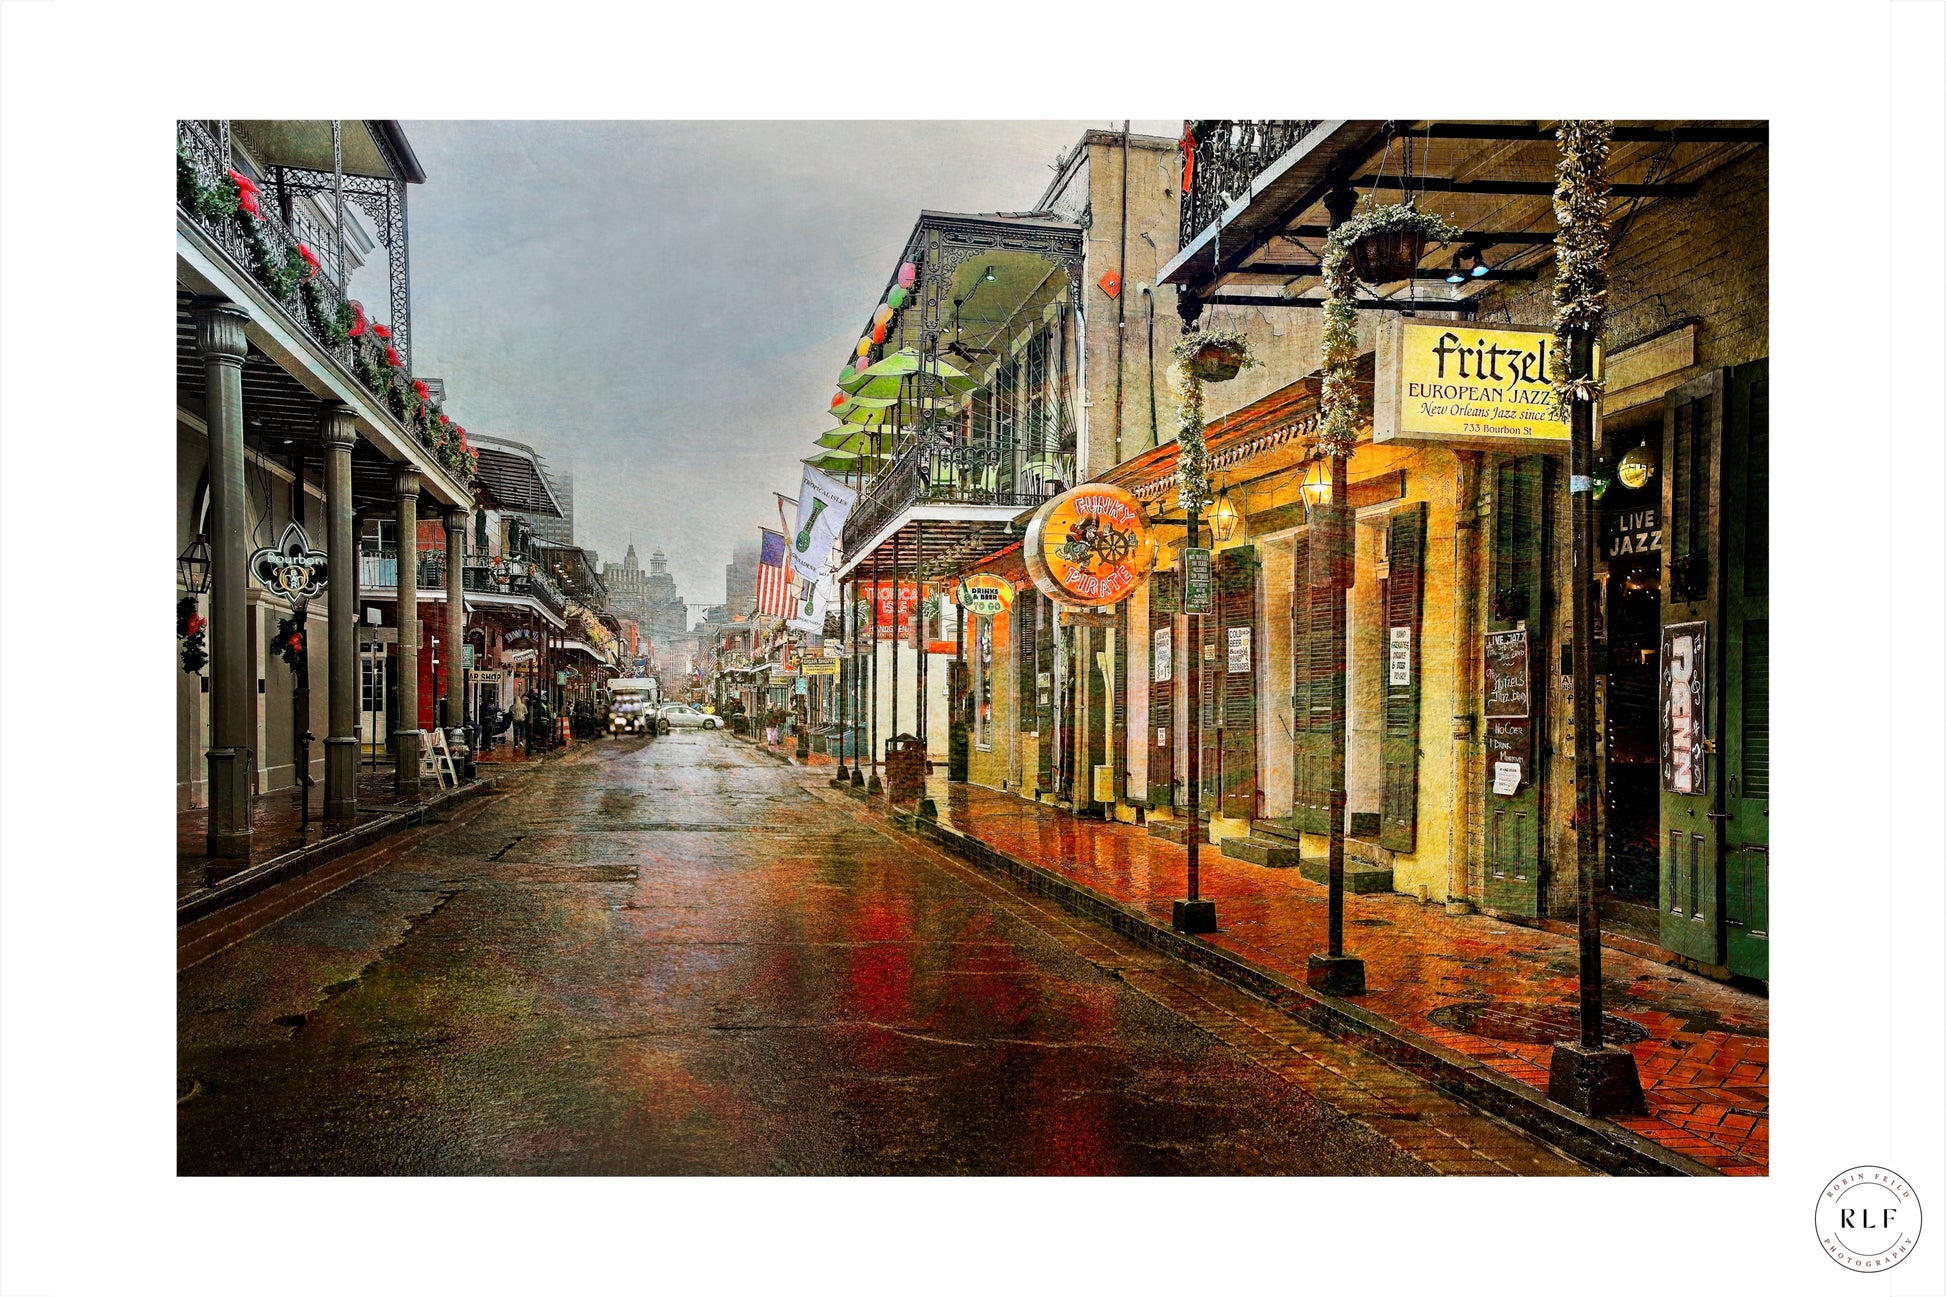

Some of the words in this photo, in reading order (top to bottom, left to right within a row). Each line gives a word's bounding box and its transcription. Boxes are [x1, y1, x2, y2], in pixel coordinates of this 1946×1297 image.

[1409, 382, 1503, 403] EUROPEAN
[1508, 389, 1551, 406] JAZZ
[1420, 402, 1448, 417] New
[1450, 403, 1490, 418] Orleans
[1490, 406, 1517, 421] Jazz
[1519, 409, 1546, 421] since
[1463, 423, 1481, 432] 733
[1483, 424, 1521, 435] Bourbon
[1523, 426, 1532, 435] St
[803, 478, 830, 500] TROPICAL
[1074, 496, 1136, 524] FUNKY
[1619, 510, 1655, 532] LIVE
[1609, 530, 1662, 557] JAZZ
[267, 551, 323, 566] Bourbon
[1064, 565, 1133, 598] PIRATE
[974, 602, 985, 610] TO
[988, 602, 1001, 610] GO
